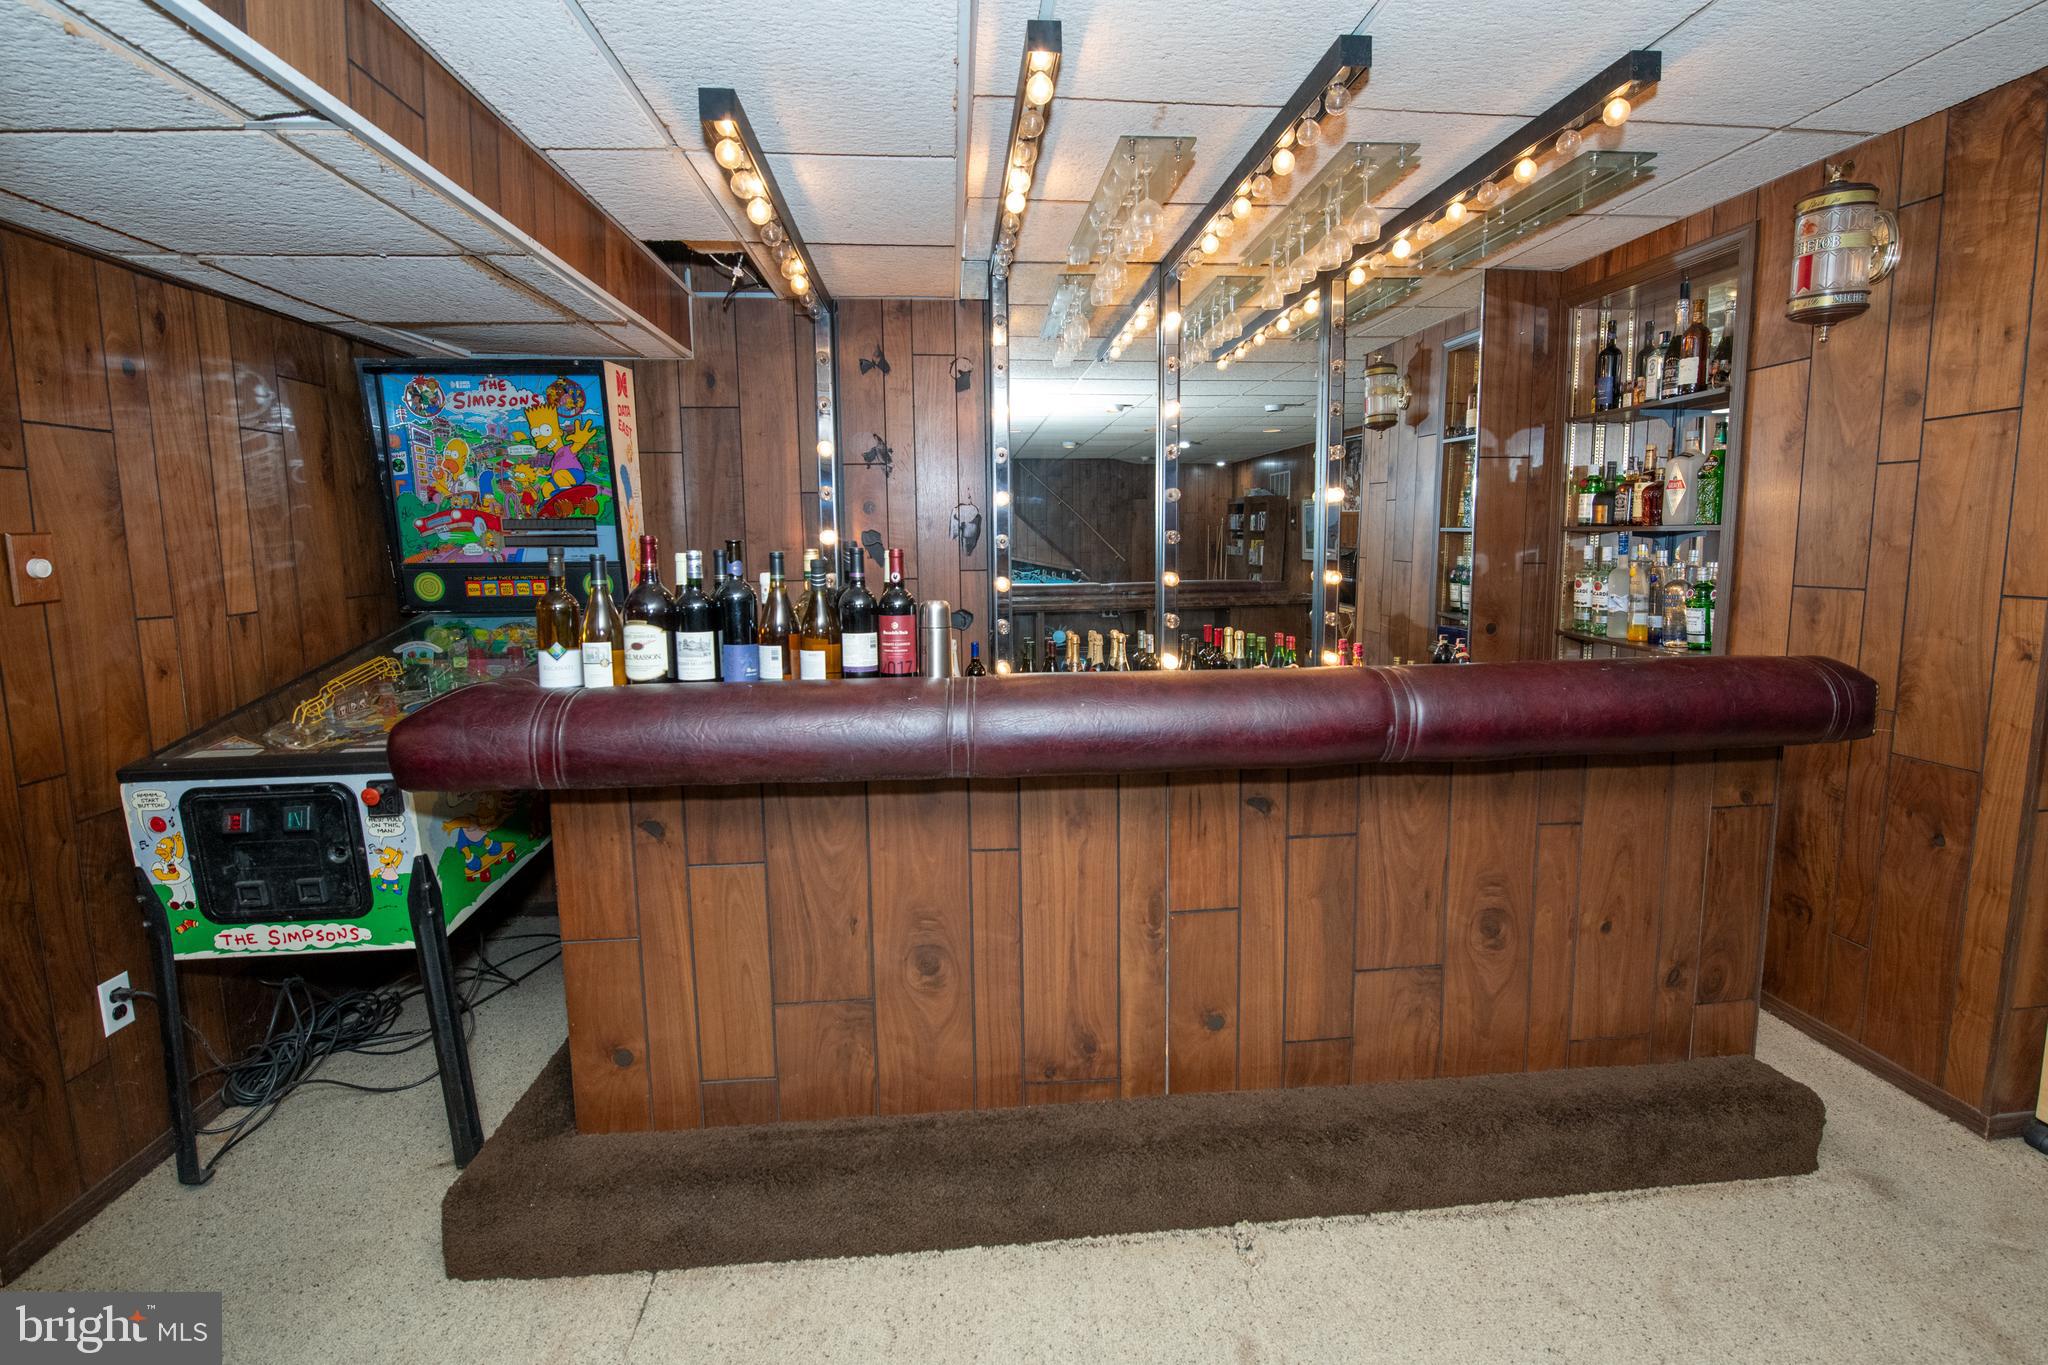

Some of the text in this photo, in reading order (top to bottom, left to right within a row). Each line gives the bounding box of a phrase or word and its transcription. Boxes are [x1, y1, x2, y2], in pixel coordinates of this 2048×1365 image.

[480, 379, 507, 392] THE
[453, 391, 541, 409] SIMPSONS
[617, 404, 631, 417] DATA
[618, 419, 632, 439] EAST
[219, 933, 258, 946] THE
